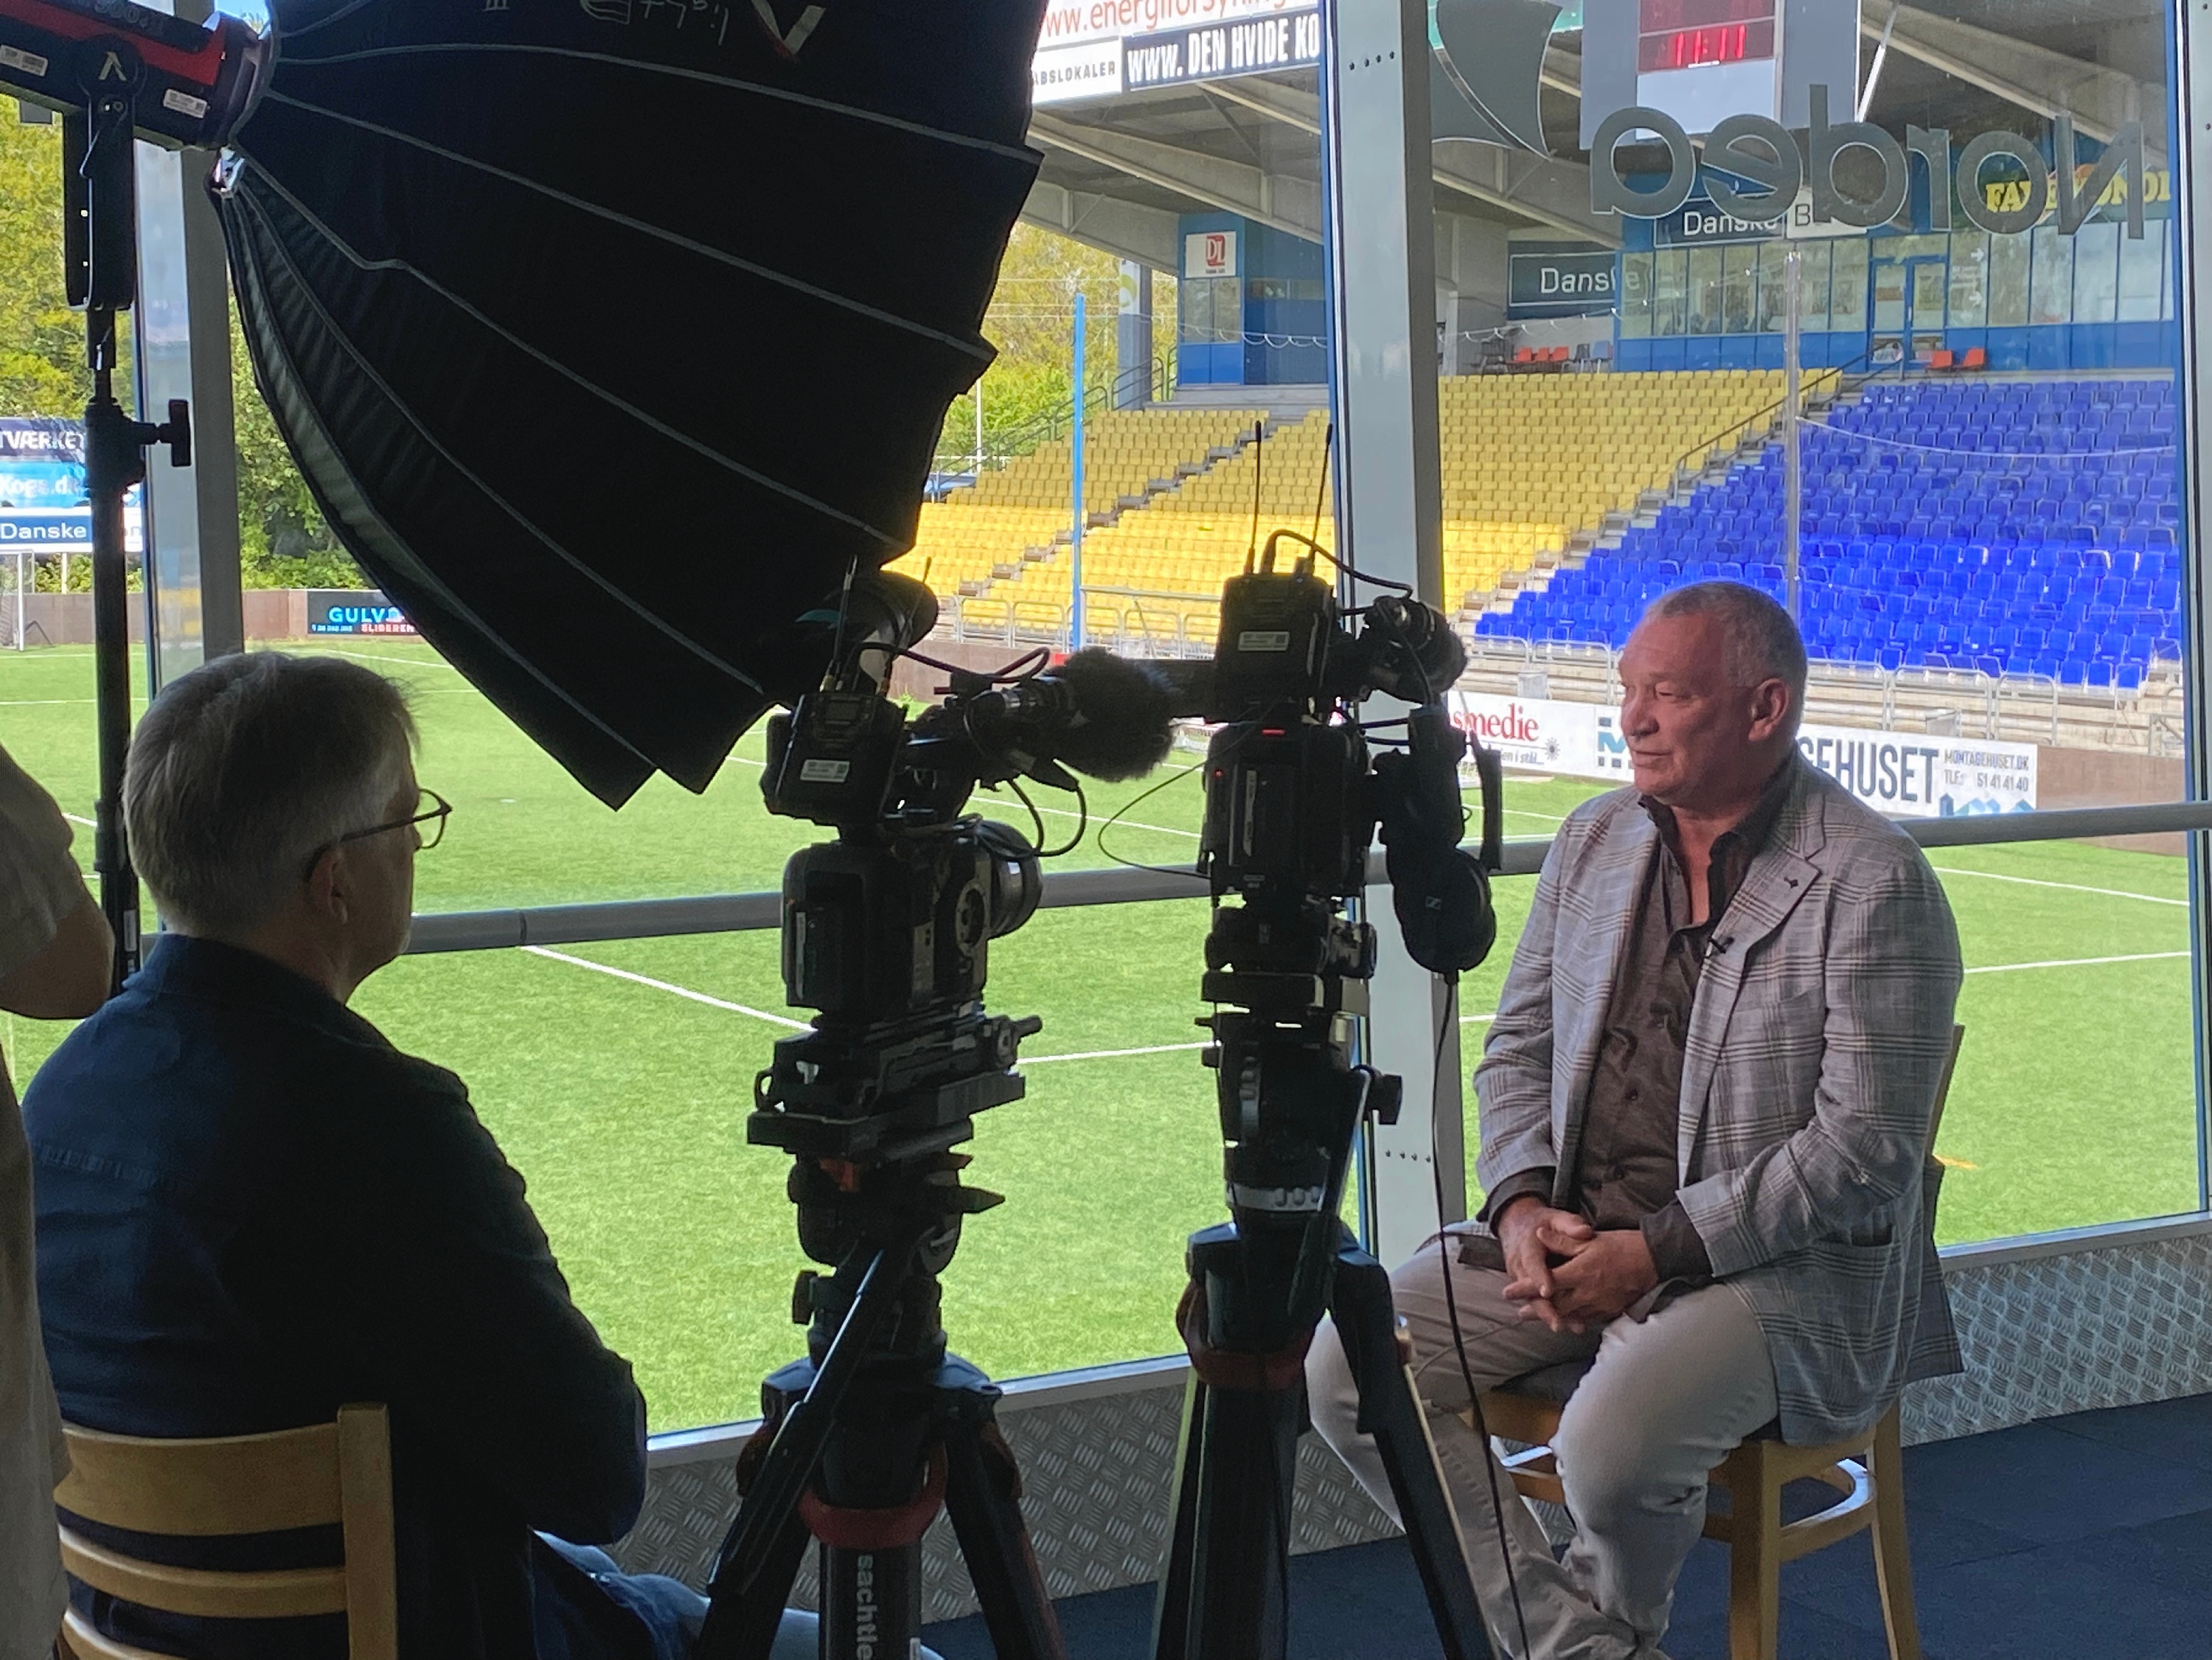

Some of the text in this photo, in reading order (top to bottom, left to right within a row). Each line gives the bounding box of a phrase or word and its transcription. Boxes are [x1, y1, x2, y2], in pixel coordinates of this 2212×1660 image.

[1188, 28, 1225, 74] DEN
[1231, 18, 1288, 69] HVIDE
[1, 522, 87, 539] Danske
[1944, 749, 2029, 771] MONTAGEHUSET.DK
[1977, 772, 1988, 788] 51
[1990, 774, 2001, 789] 41
[2003, 775, 2014, 791] 41
